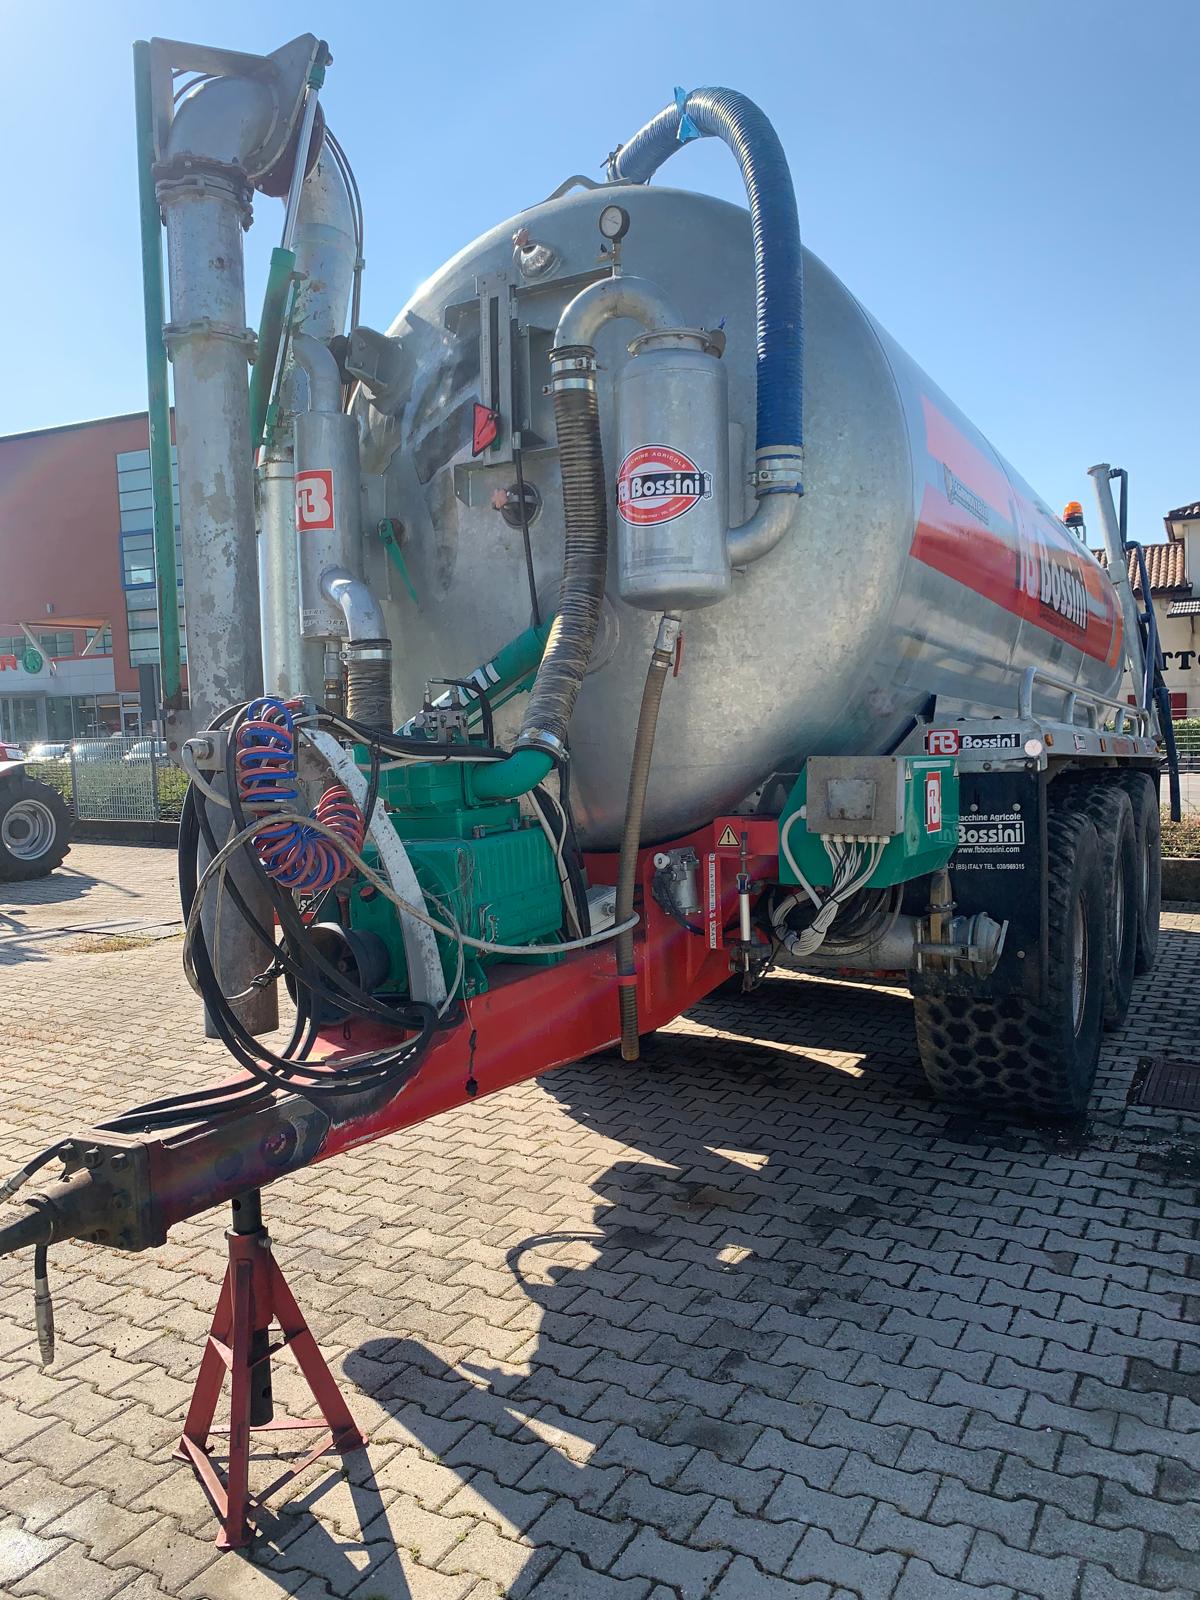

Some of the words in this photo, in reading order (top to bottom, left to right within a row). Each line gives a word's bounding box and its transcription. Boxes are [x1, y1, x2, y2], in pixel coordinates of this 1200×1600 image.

[651, 452, 686, 469] AGRICOLE
[631, 473, 700, 499] Bossini
[0, 654, 17, 671] R
[929, 731, 957, 754] FB
[962, 734, 1015, 749] Bossini
[959, 813, 988, 822] acchine
[990, 813, 1021, 822] Agricole
[958, 824, 1021, 843] Bossini
